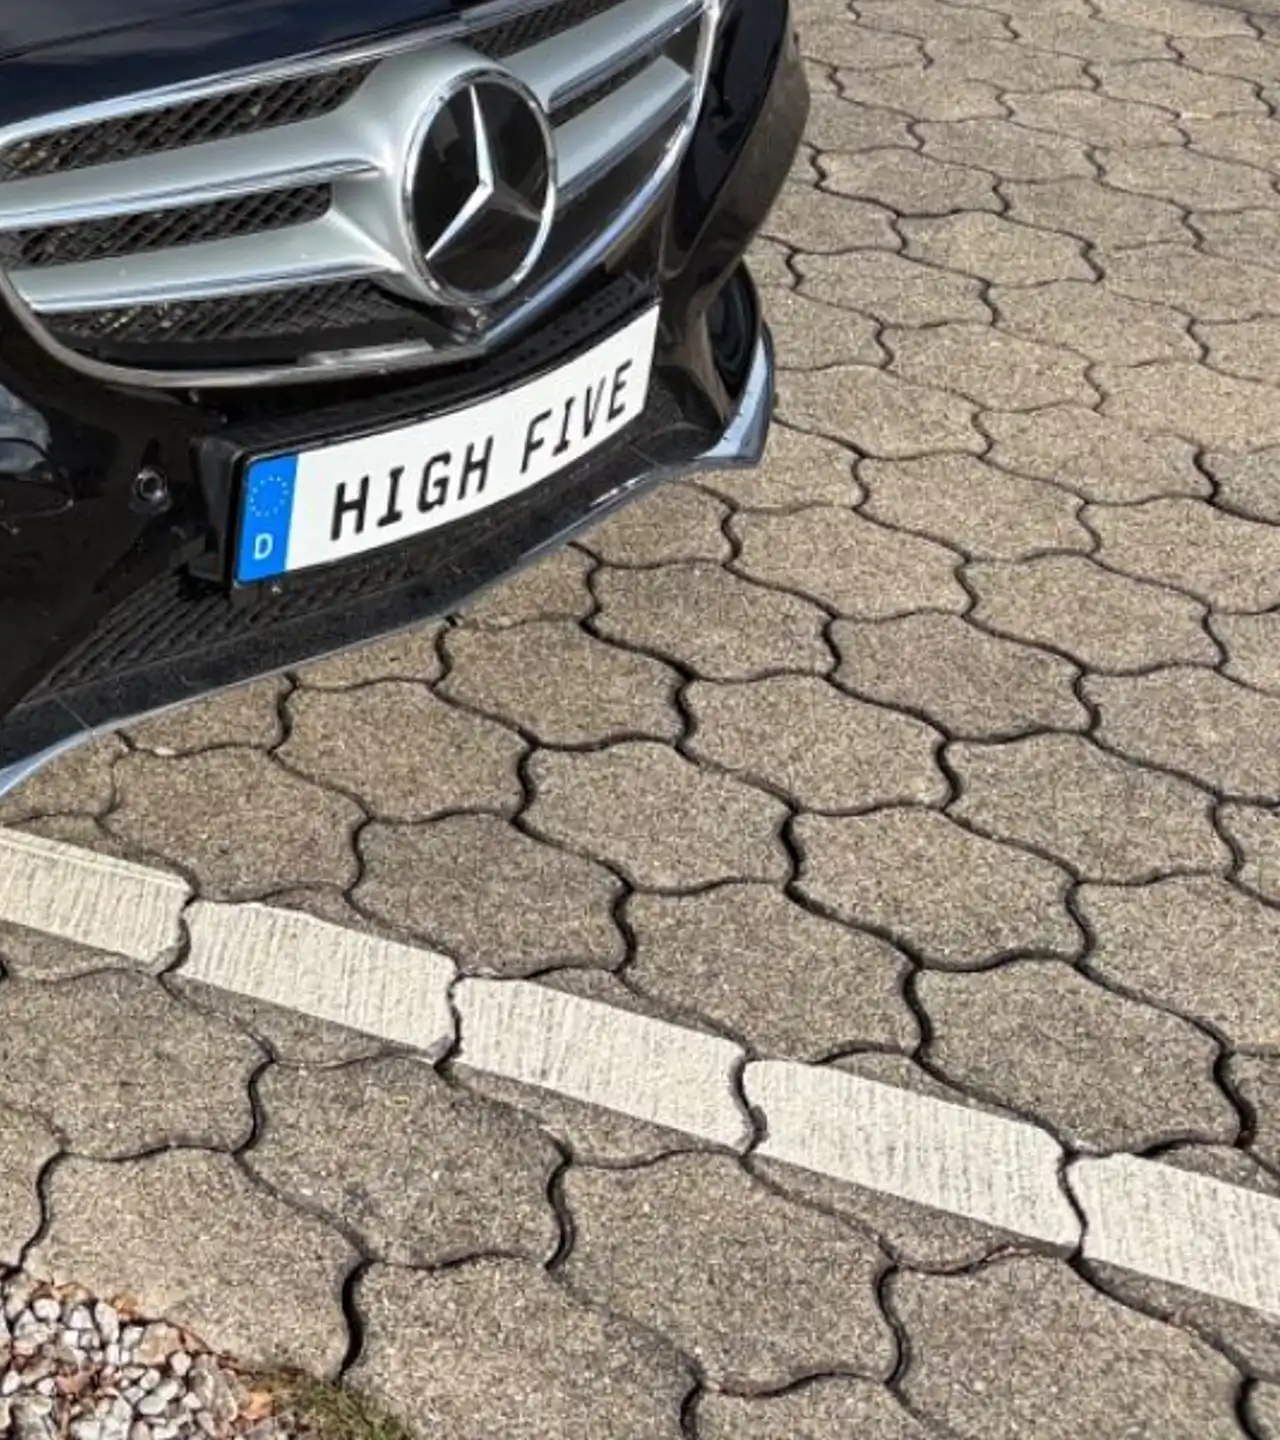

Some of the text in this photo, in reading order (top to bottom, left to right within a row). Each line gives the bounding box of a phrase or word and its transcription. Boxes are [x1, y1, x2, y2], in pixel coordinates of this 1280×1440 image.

[330, 359, 633, 541] HIGH FIVE
[254, 533, 273, 560] D
